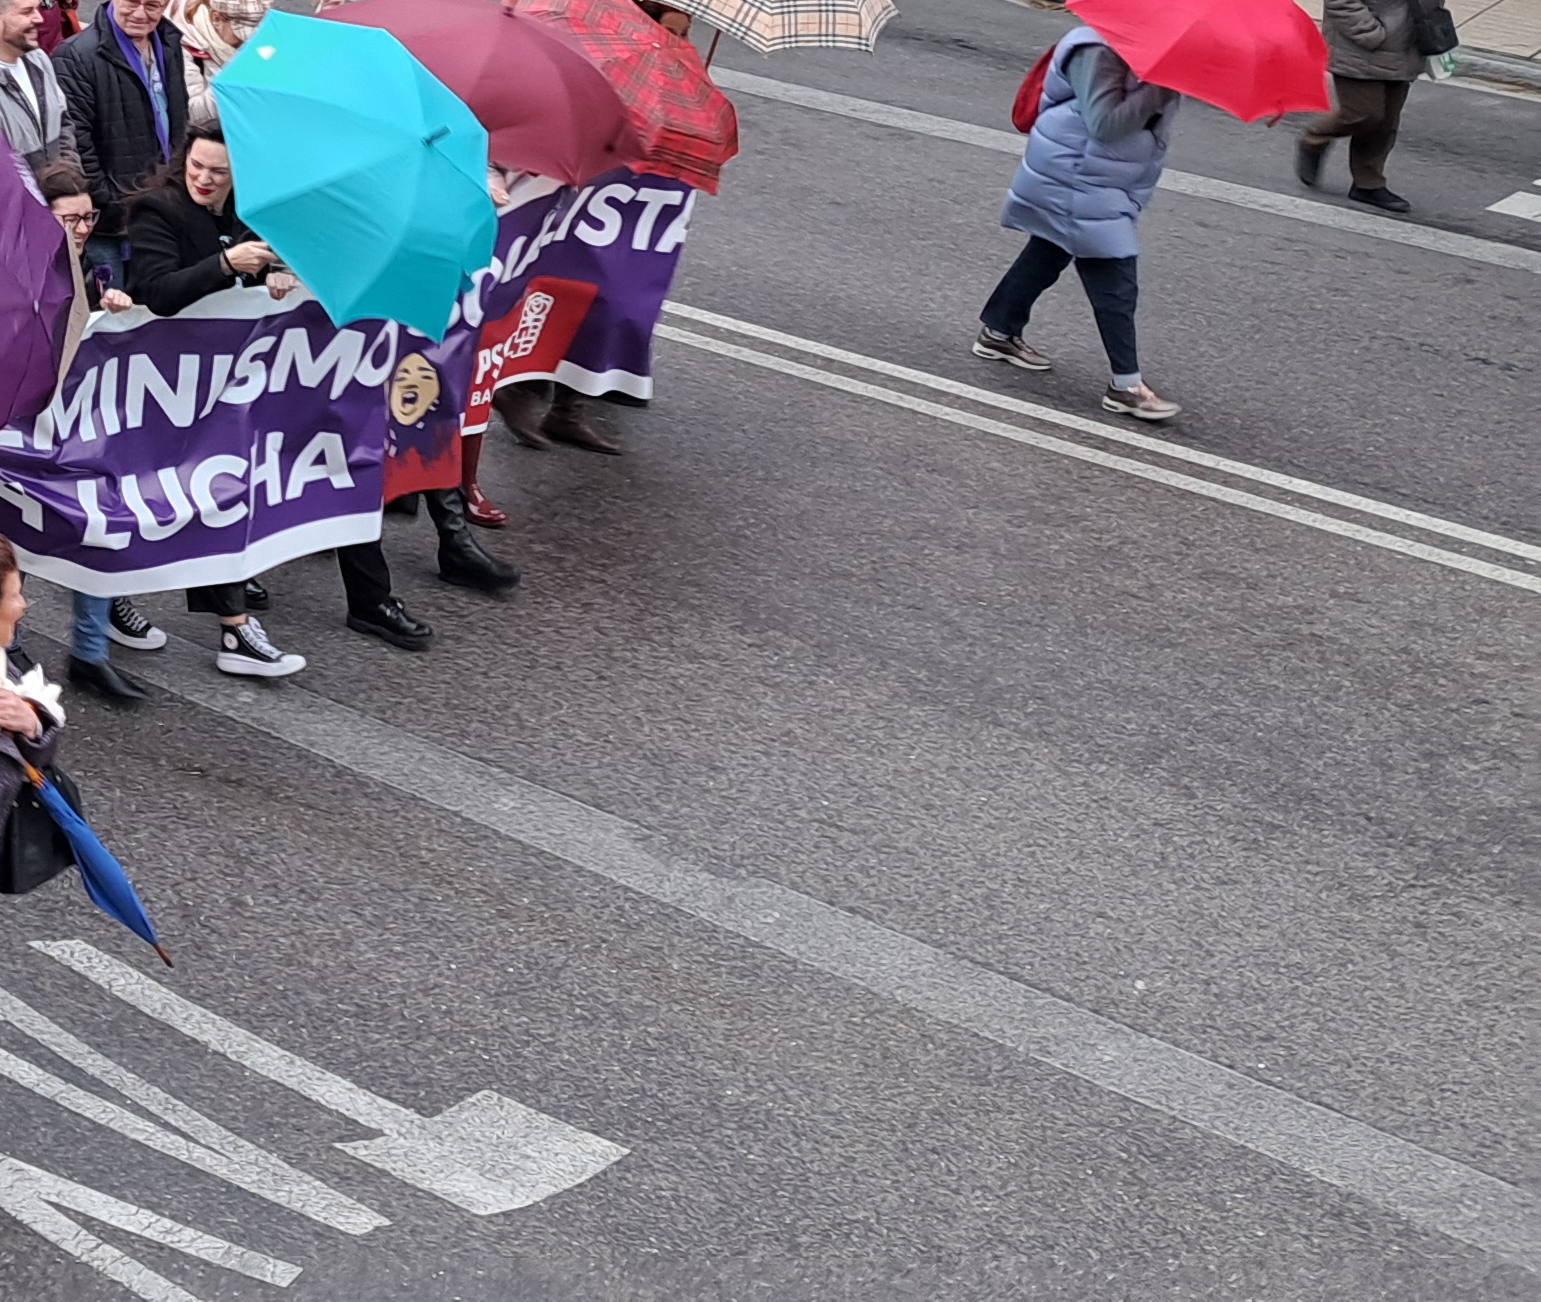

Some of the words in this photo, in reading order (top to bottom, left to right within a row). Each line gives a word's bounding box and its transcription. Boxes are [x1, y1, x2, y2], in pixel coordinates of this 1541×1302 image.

[474, 343, 505, 385] PS
[470, 388, 494, 407] BA
[77, 432, 356, 551] LUCHA
